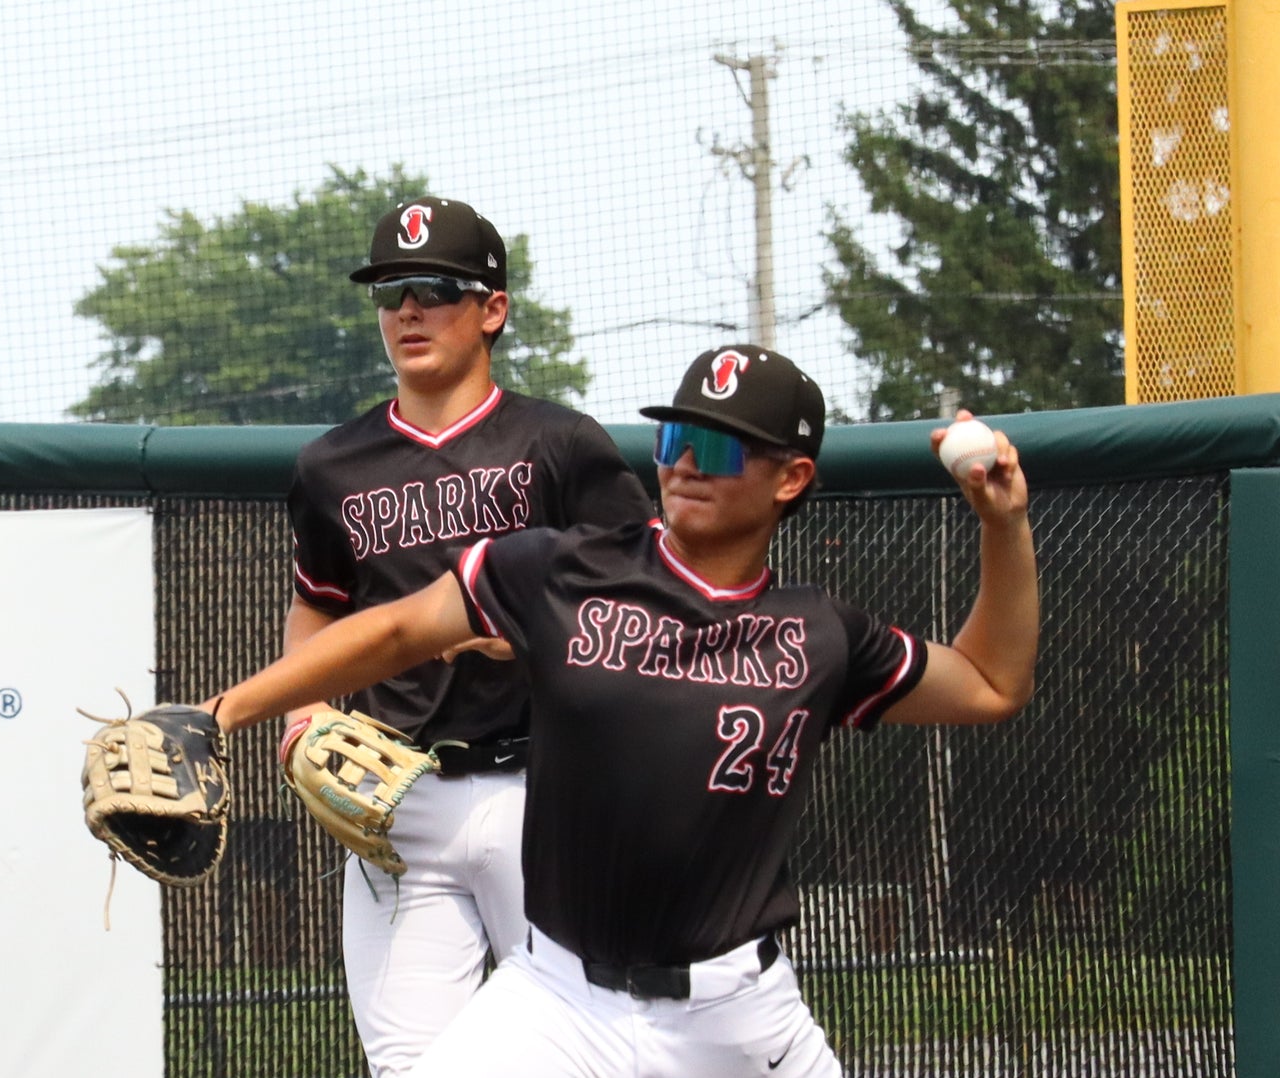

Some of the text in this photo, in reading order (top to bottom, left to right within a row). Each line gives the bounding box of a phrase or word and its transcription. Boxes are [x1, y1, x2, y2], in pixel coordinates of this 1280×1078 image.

[341, 461, 533, 561] SPARKS
[567, 597, 809, 689] SPARKS
[708, 705, 809, 796] 24
